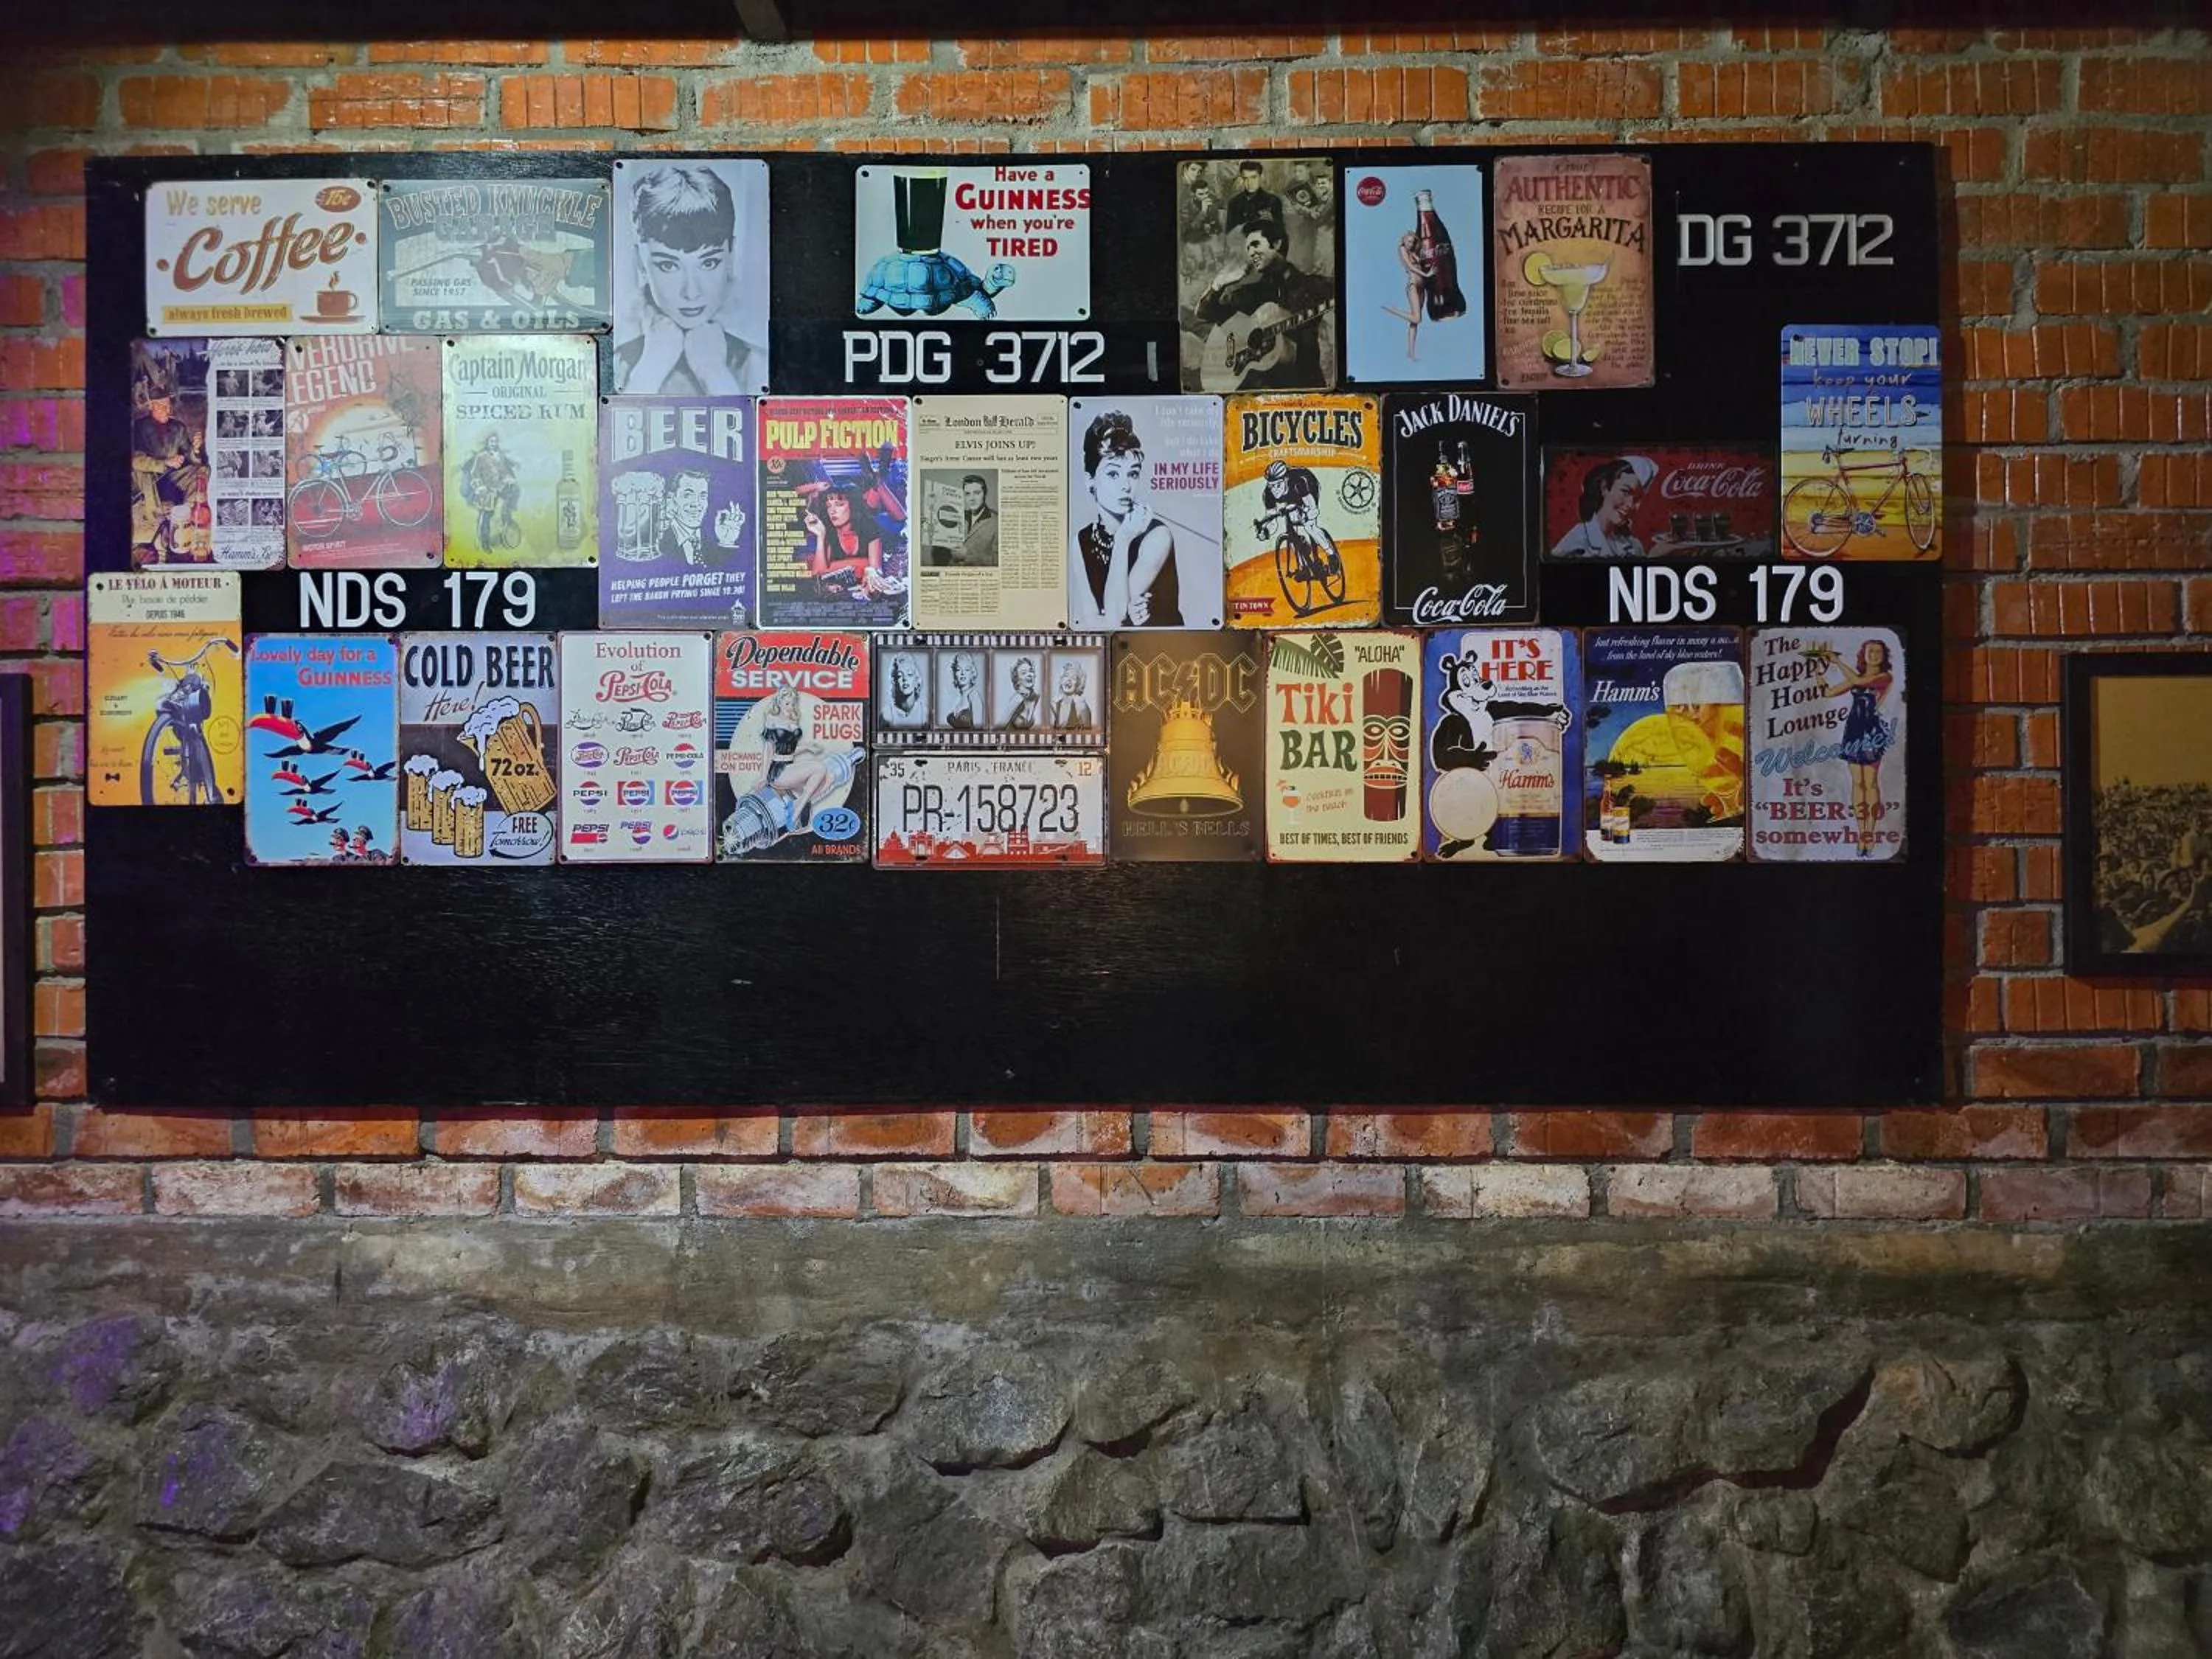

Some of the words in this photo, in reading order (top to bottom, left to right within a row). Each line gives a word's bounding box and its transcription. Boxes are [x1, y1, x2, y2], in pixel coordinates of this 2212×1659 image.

[995, 166, 1037, 182] Have
[1044, 170, 1054, 182] a
[955, 183, 1091, 210] GUINNESS
[1503, 174, 1641, 204] AUTHENTIC
[167, 189, 199, 216] We
[206, 194, 262, 215] serve
[386, 184, 481, 231] BUSTED
[487, 184, 603, 229] KNUCKLE
[1537, 204, 1572, 215] RECIPE
[1576, 204, 1593, 215] FOR
[1596, 204, 1607, 215] A
[970, 215, 1018, 230] when
[1023, 215, 1075, 234] you're
[1496, 216, 1645, 256] MARGARITA
[1676, 213, 1753, 266] DG
[1772, 213, 1894, 266] 3712
[173, 212, 355, 295] Coffee
[986, 237, 1059, 257] TIRED
[411, 277, 451, 287] PASSING
[453, 277, 472, 287] GAS
[411, 287, 440, 296] SINCE
[168, 307, 209, 320] always
[211, 305, 242, 319] fresh
[244, 304, 288, 319] brewed
[412, 310, 470, 330] GAS
[480, 310, 501, 330] &
[511, 308, 580, 330] OILS
[843, 330, 953, 383] PDG
[984, 330, 1106, 383] 3712
[1789, 336, 1860, 366] NEVER
[448, 350, 515, 385] Captain
[516, 349, 588, 384] Morgan
[1812, 368, 1856, 389] keep
[1864, 372, 1913, 395] your
[491, 384, 547, 400] ORIGINAL
[456, 403, 532, 420] SPICED
[538, 403, 586, 420] RUM
[1399, 403, 1445, 437] JACK
[1447, 394, 1520, 437] DANIEL'S
[1806, 394, 1918, 428] WHEELS
[944, 415, 982, 428] London
[998, 415, 1035, 428] Herald
[1241, 408, 1363, 453] BICYCLES
[611, 406, 743, 463] BEER
[766, 420, 817, 450] PULP
[819, 419, 899, 450] FICTION
[1837, 429, 1899, 449] turning
[955, 440, 984, 449] ELVIS
[985, 440, 1016, 451] JOINS
[1269, 447, 1337, 458] CRAFTSMANSHIP
[1153, 462, 1167, 476] IN
[1171, 462, 1189, 476] MY
[1192, 462, 1220, 476] LIFE
[1686, 462, 1725, 470] DRINK
[1150, 476, 1219, 491] SERIOUSLY
[1660, 467, 1767, 500] Coca-Cola
[108, 579, 124, 591] LE
[173, 577, 223, 589] MOTEUR
[611, 577, 647, 591] HELPING
[648, 576, 681, 589] PEOPLE
[682, 571, 725, 588] FORGET
[726, 571, 746, 583] THEY
[299, 571, 407, 628] NDS
[443, 571, 537, 629] 179
[1412, 583, 1509, 625] Coca-Cola
[1609, 565, 1718, 623] NDS
[1748, 565, 1844, 623] 179
[251, 645, 302, 665] Lovely
[307, 645, 335, 665] day
[339, 646, 362, 662] for
[366, 650, 377, 662] a
[596, 641, 682, 658] Evolution
[726, 636, 859, 672] Dependable
[1491, 638, 1540, 659] IT'S
[1764, 636, 1801, 656] The
[404, 644, 473, 688] COLD
[485, 644, 555, 689] BEER
[631, 660, 644, 672] of
[1479, 661, 1554, 681] HERE
[1756, 655, 1831, 687] Happy
[298, 668, 393, 686] GUINNESS
[731, 669, 853, 689] SERVICE
[424, 681, 486, 722] Here!
[1590, 680, 1661, 703] Hamm's
[1771, 683, 1829, 710] Hour
[813, 703, 861, 720] SPARK
[1276, 681, 1354, 726] Tiki
[813, 722, 862, 740] PLUGS
[1767, 706, 1848, 740] Lounge
[720, 751, 762, 761] MECHANIC
[1279, 729, 1357, 772] BAR
[720, 761, 736, 771] ON
[738, 760, 762, 772] DUTY
[889, 762, 905, 777] 35
[992, 761, 1033, 773] FRANCE
[1079, 762, 1092, 776] 12
[1500, 767, 1555, 789] Hamm's
[1782, 778, 1823, 797] It's
[573, 789, 608, 797] PEPSI
[623, 789, 650, 797] PEPSI
[902, 784, 1080, 833] PR-158723
[512, 816, 538, 834] FREE
[572, 823, 610, 833] PEPSI
[620, 821, 653, 830] PEPSI
[1192, 820, 1251, 837] BELLS
[1755, 825, 1900, 845] somewhere
[490, 830, 549, 852] Tomorrow!
[1279, 832, 1299, 845] BEST
[1301, 832, 1312, 845] OF
[1314, 832, 1340, 846] TIMES,
[1341, 832, 1362, 845] BEST
[1363, 832, 1374, 845] OF
[1375, 832, 1409, 845] FRIENDS
[824, 844, 862, 856] BRANDS
